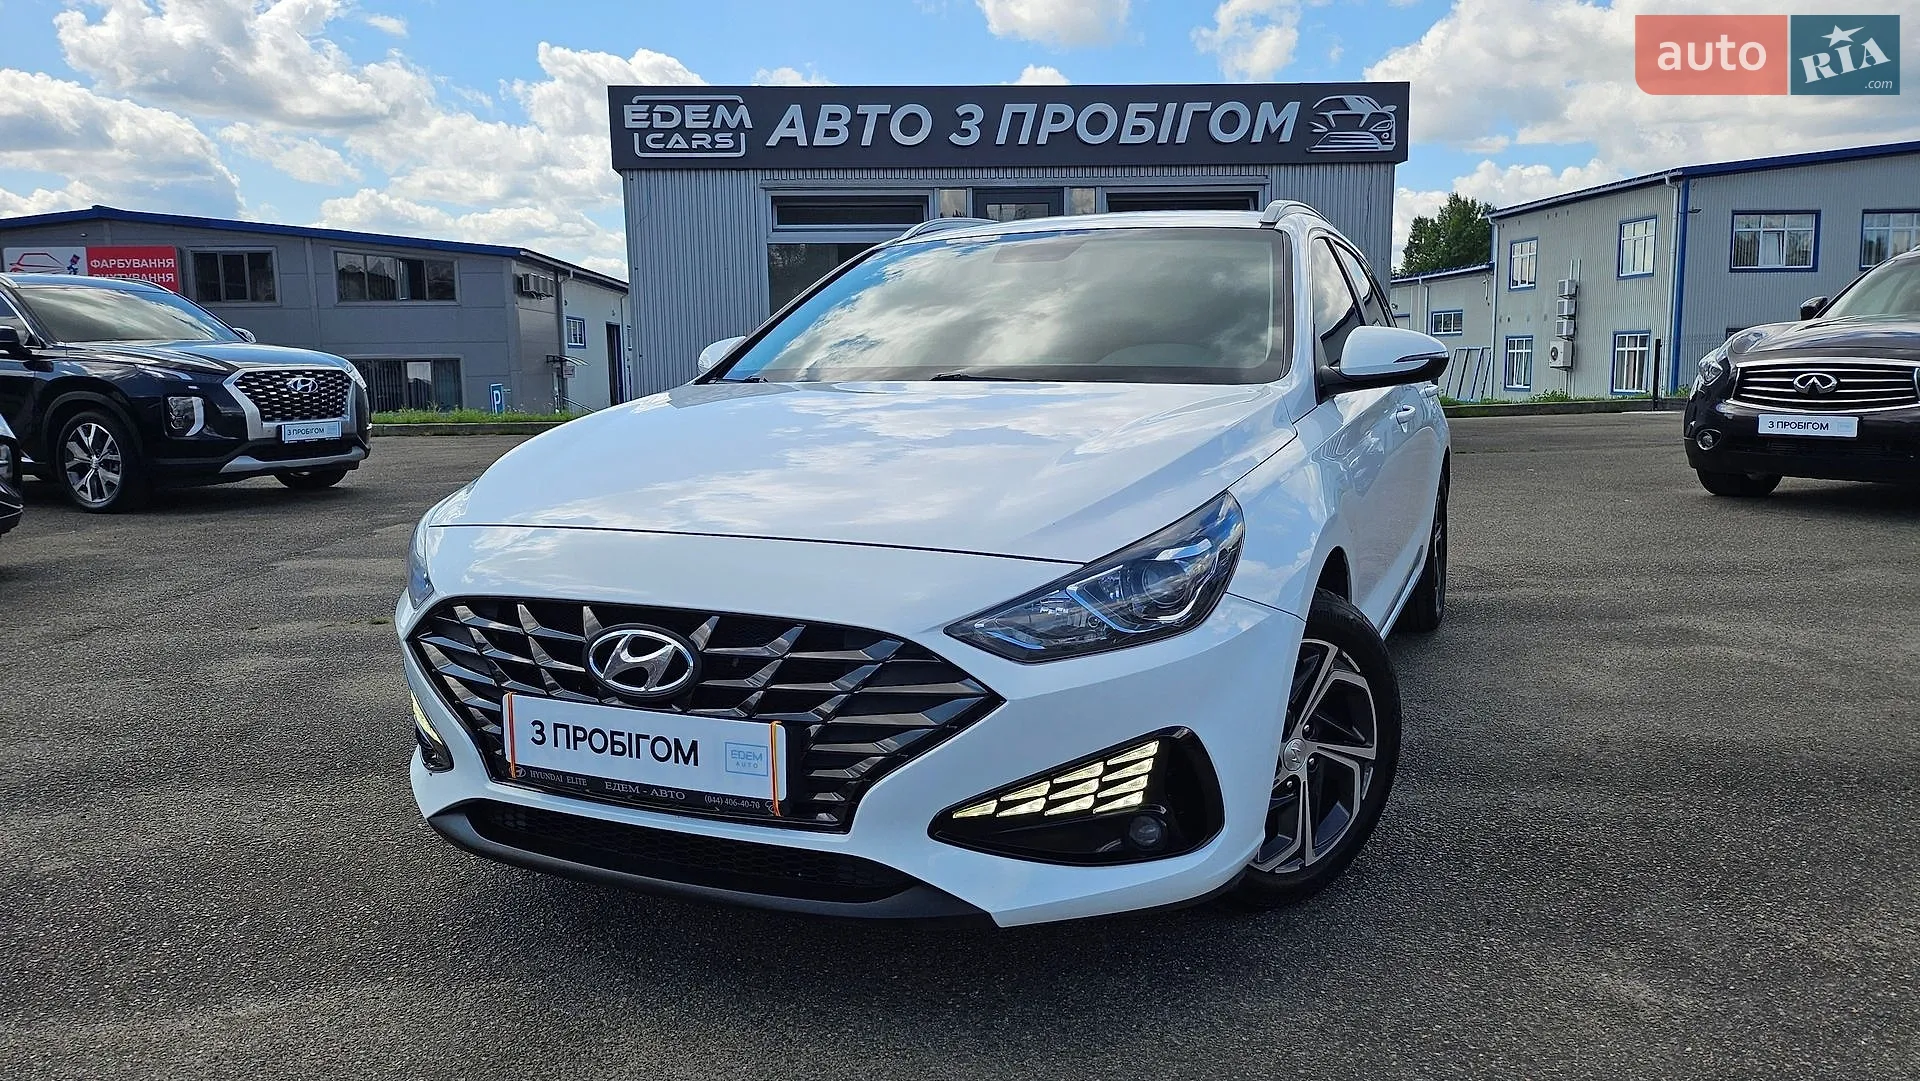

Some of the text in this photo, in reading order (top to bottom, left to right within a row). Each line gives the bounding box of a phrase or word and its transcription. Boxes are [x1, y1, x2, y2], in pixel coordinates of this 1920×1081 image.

[623, 103, 754, 129] EDEM
[765, 101, 1301, 147] АВТО З ПРОБІГОМ
[645, 132, 735, 149] CARS
[90, 258, 175, 269] ФАРБУВАННЯ
[292, 427, 325, 435] ПРОБІГОМ
[1768, 421, 1775, 429] З
[1776, 421, 1829, 431] ПРОБІГОМ
[530, 720, 699, 767] З ПРОБІГОМ
[730, 749, 763, 761] EDEM
[735, 761, 759, 769] AUTO
[530, 769, 588, 787] HYUNDAI ELITE
[605, 781, 640, 794] ЕДЕМ
[650, 788, 686, 800] АВТО
[704, 794, 761, 809] (044) 406-40-70
